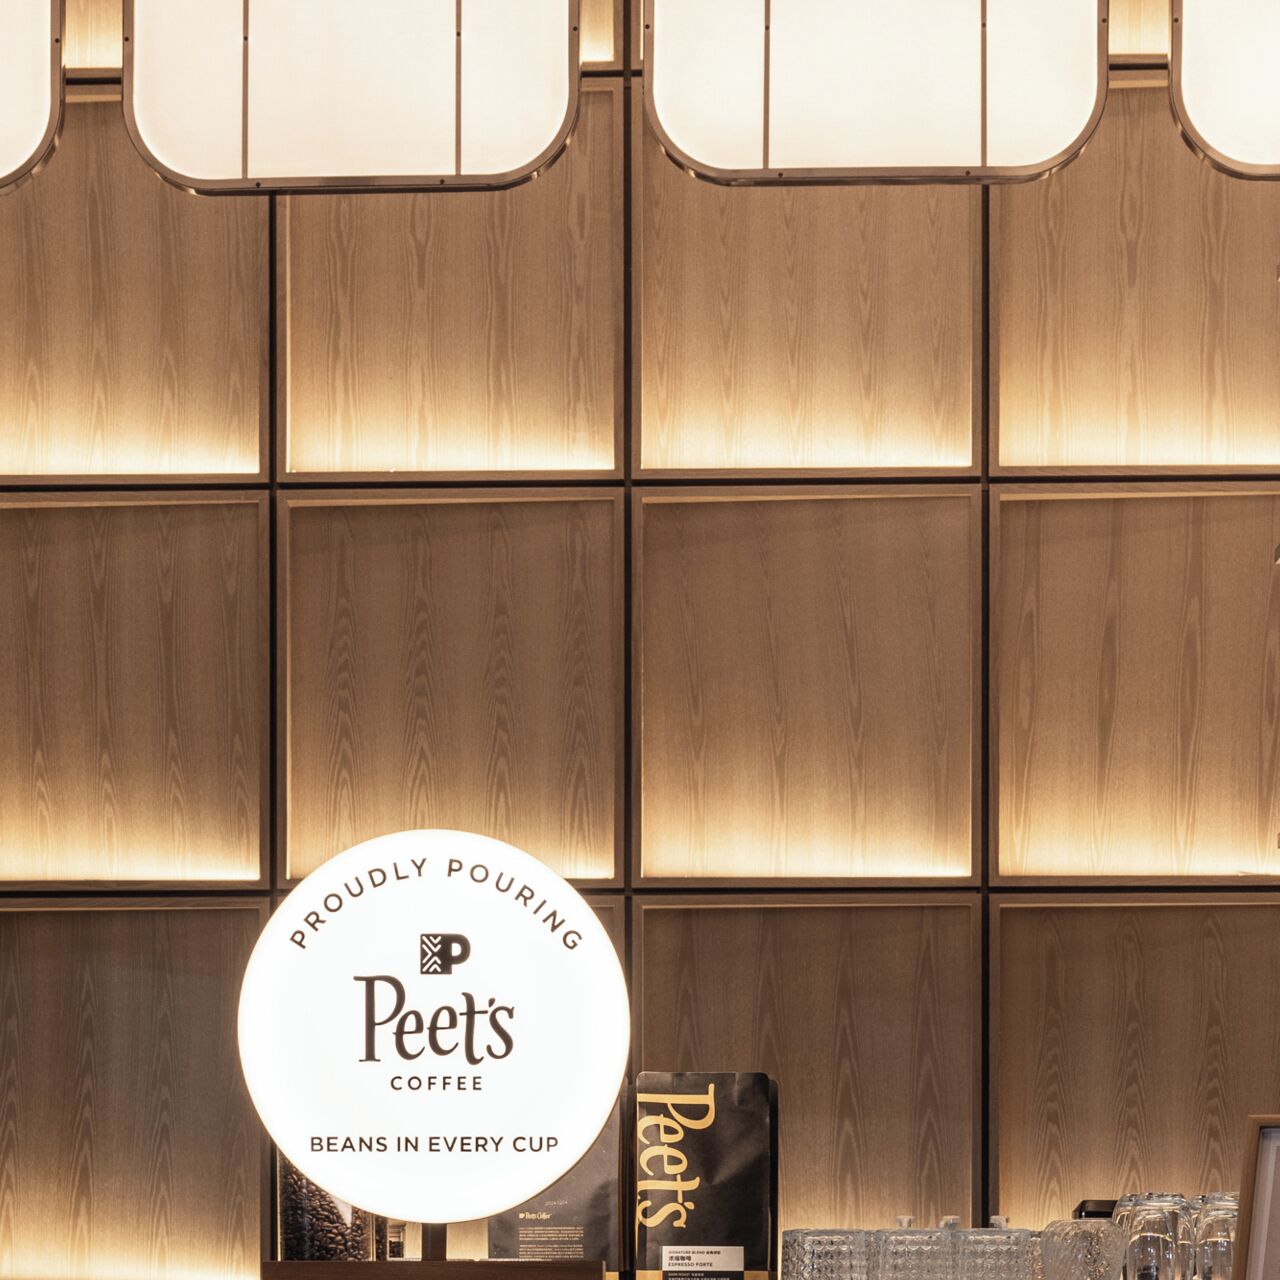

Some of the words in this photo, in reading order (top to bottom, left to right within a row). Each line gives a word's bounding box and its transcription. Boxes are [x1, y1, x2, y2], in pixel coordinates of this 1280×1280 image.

[289, 857, 428, 950] PROUDLY
[447, 858, 583, 950] POURING
[353, 975, 515, 1066] Peet's
[390, 1075, 483, 1091] COFFEE
[310, 1136, 388, 1153] BEANS
[397, 1136, 419, 1153] IN
[428, 1136, 503, 1153] EVERY
[512, 1136, 558, 1153] CUP
[637, 1082, 716, 1228] Peet's
